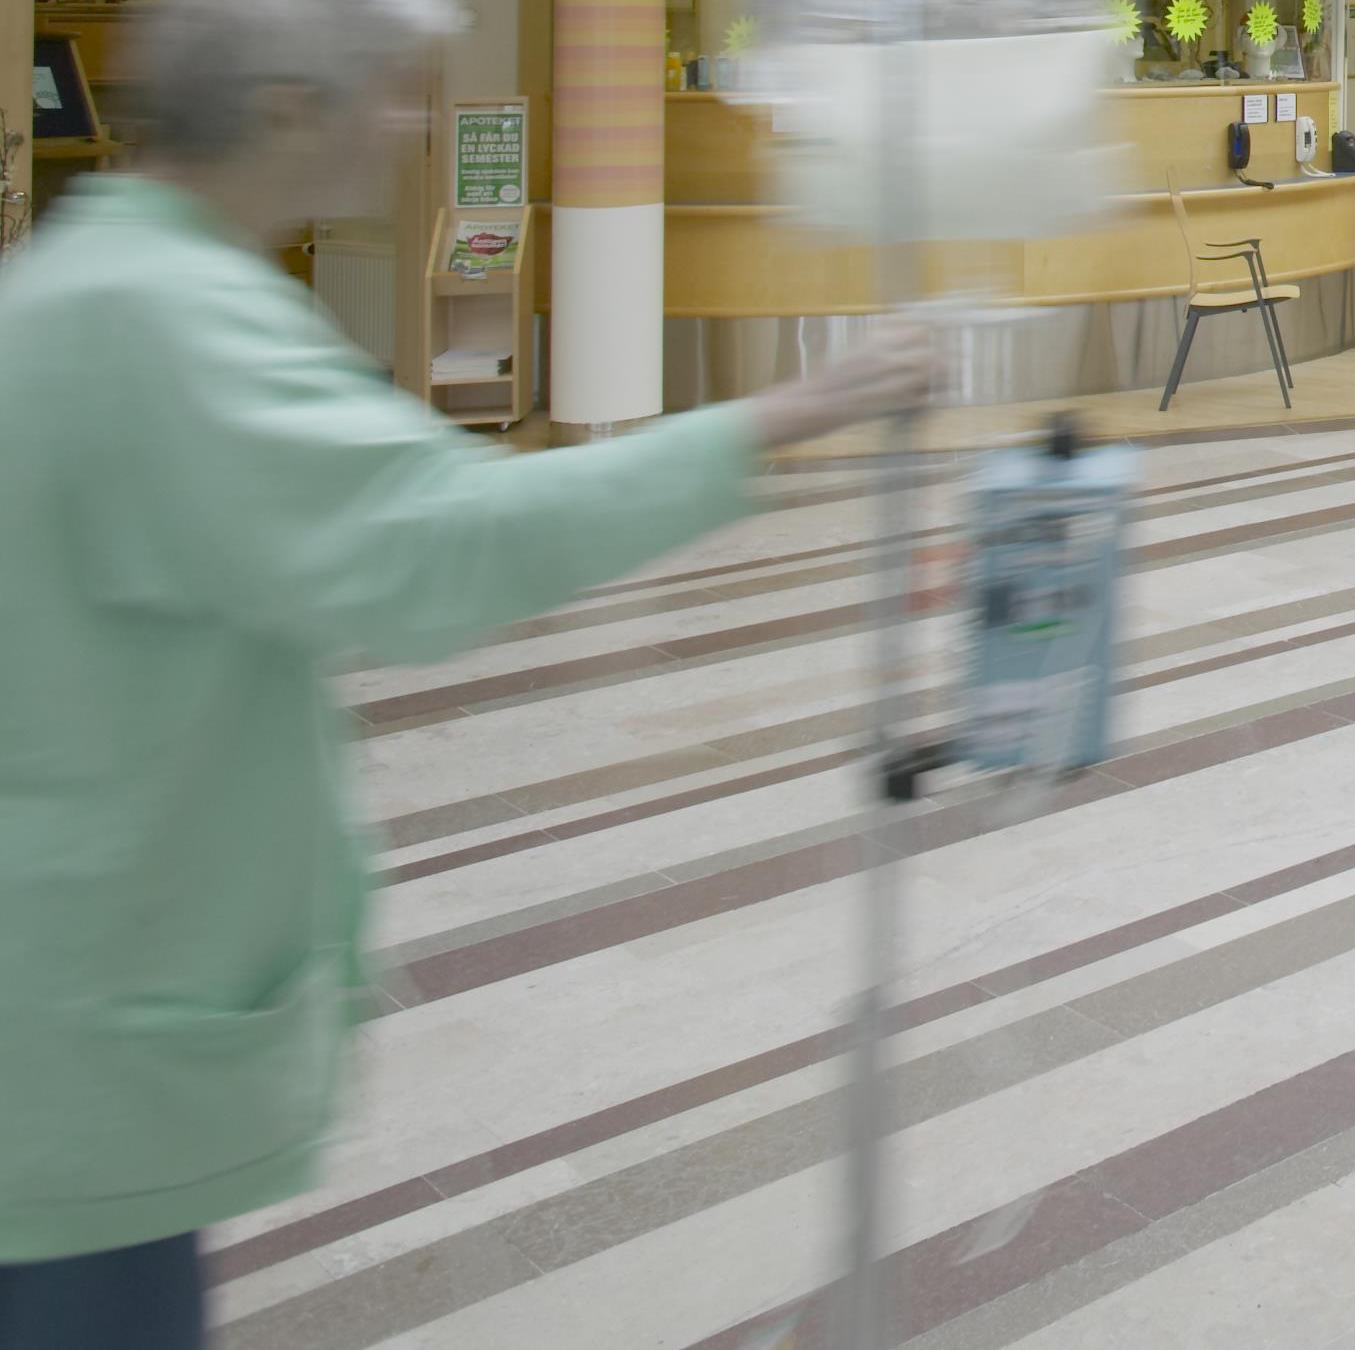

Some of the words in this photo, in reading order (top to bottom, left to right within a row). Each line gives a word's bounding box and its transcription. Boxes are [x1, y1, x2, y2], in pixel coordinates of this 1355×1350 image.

[460, 116, 521, 126] APOTEKET
[463, 131, 477, 143] SÅ
[479, 131, 501, 143] FÅR
[502, 132, 519, 142] DU
[461, 143, 475, 153] EN
[478, 143, 520, 153] LYCKAD
[461, 153, 519, 164] SEMESTER
